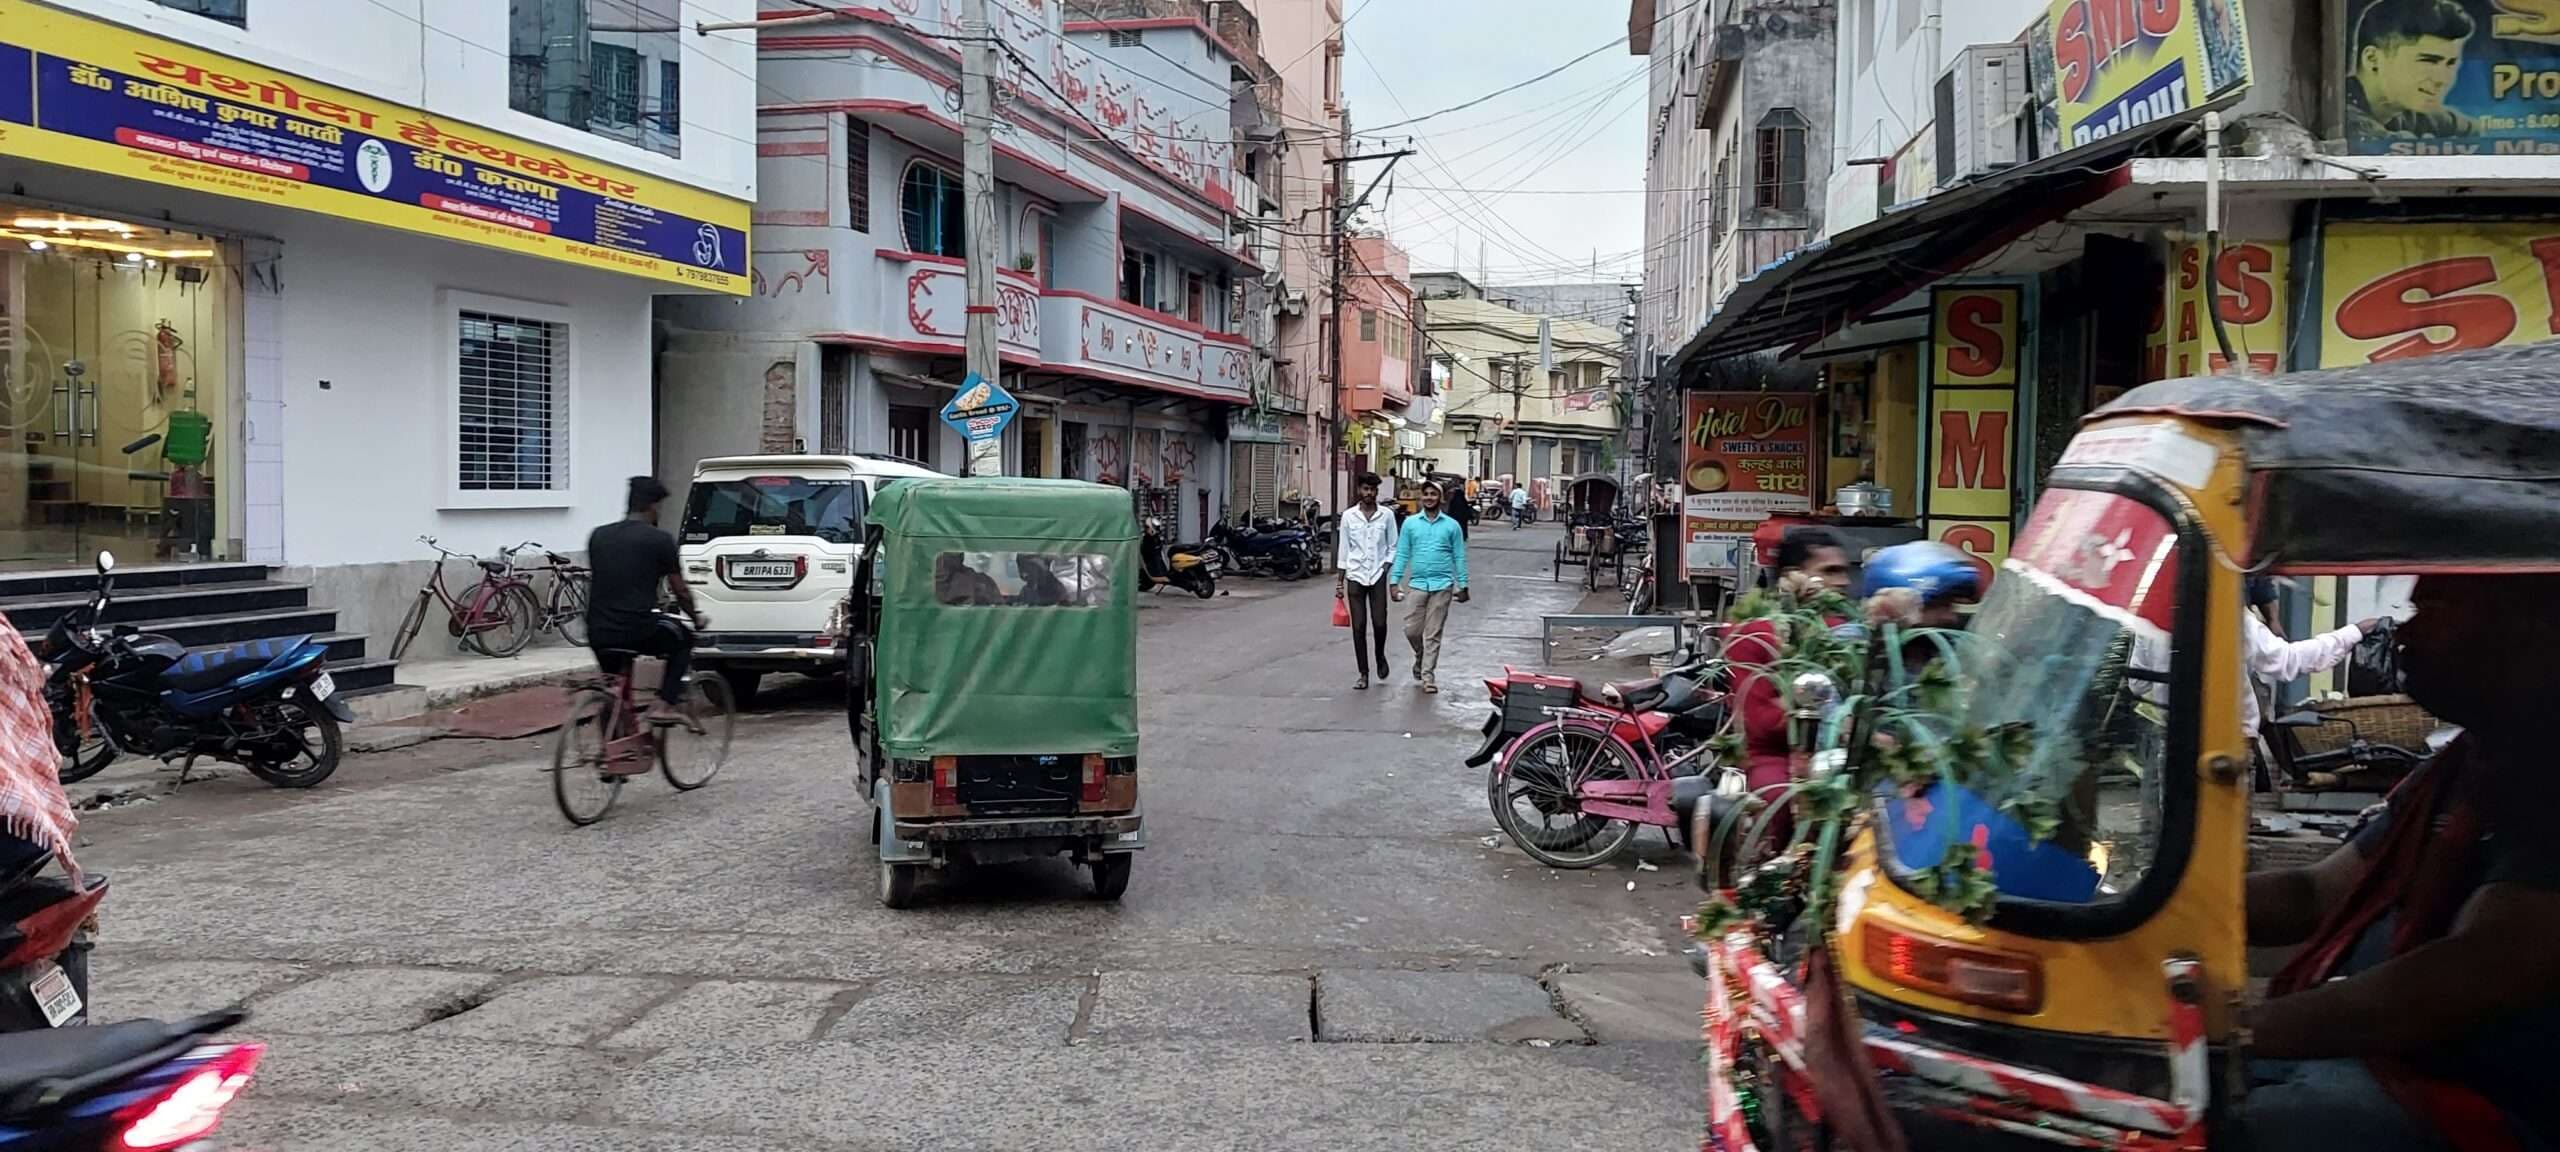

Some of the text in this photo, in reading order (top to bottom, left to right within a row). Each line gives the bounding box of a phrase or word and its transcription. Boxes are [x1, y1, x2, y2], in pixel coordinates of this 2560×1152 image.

[134, 51, 380, 130] यशोदा
[395, 119, 640, 200] हेल्थकेयर
[214, 101, 279, 130] कुमार
[286, 117, 345, 146] भारती
[2480, 115, 2515, 131] Time
[1691, 406, 1749, 449] Hotel
[1722, 441, 1758, 453] SWEETS
[1768, 441, 1805, 454] SNACKS
[1755, 473, 1806, 491] चाय
